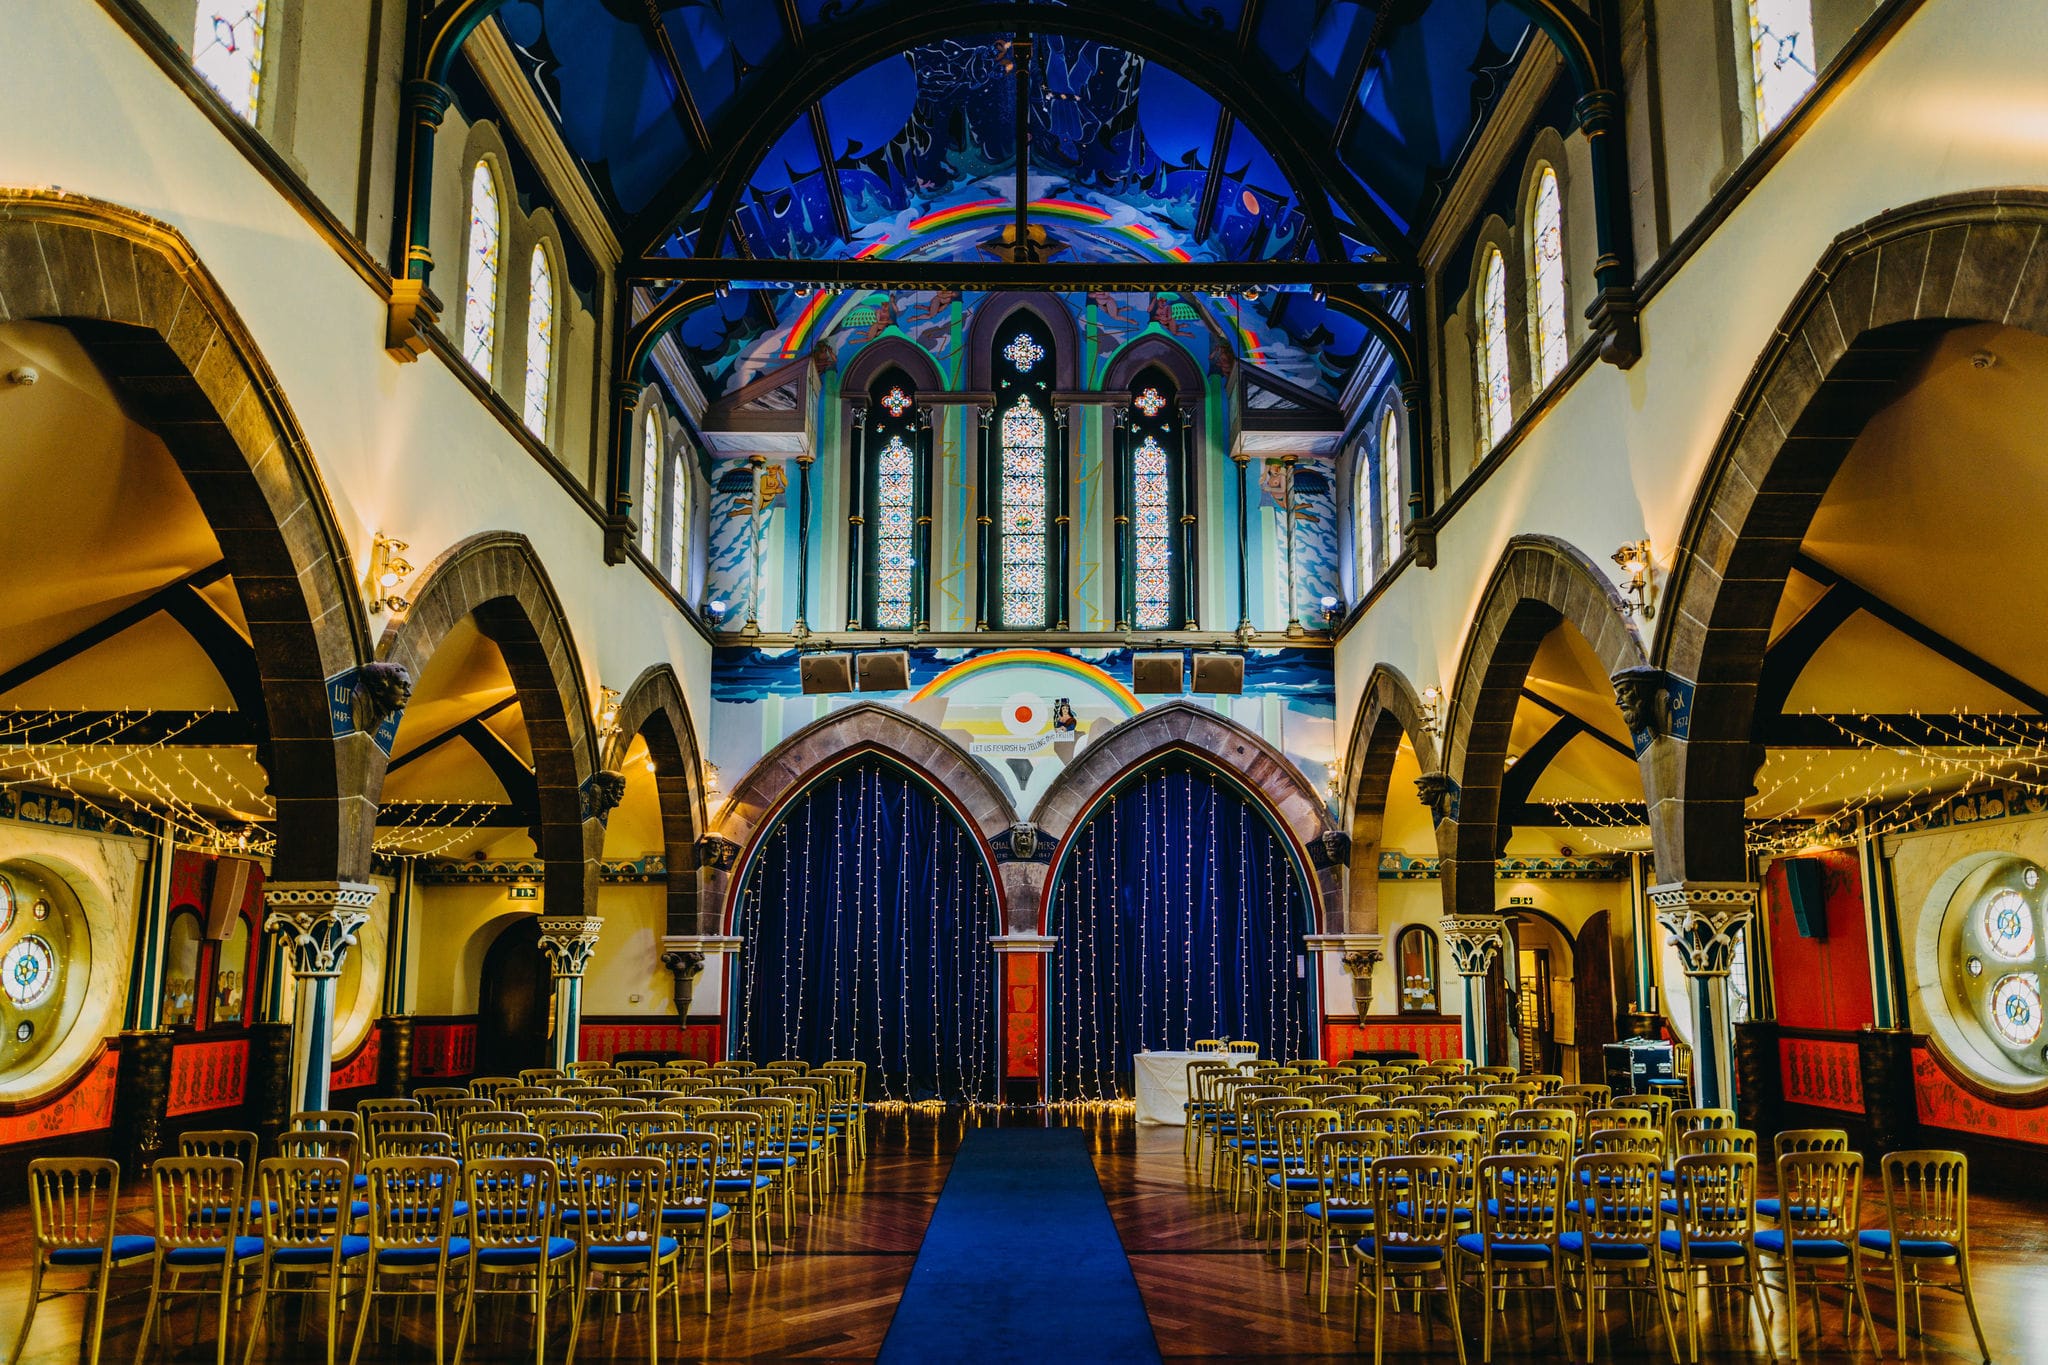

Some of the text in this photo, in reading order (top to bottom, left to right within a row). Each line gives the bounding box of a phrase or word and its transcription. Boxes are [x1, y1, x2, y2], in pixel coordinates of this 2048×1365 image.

[801, 281, 854, 289] THE
[861, 282, 951, 291] GLORY
[959, 283, 996, 291] OF
[1049, 284, 1103, 292] OUR
[1110, 284, 1240, 292] UNIVERSE
[334, 684, 351, 705] LUT
[973, 744, 983, 753] LET
[984, 744, 992, 752] US
[1019, 744, 1027, 752] by
[1027, 737, 1046, 751] TELLING
